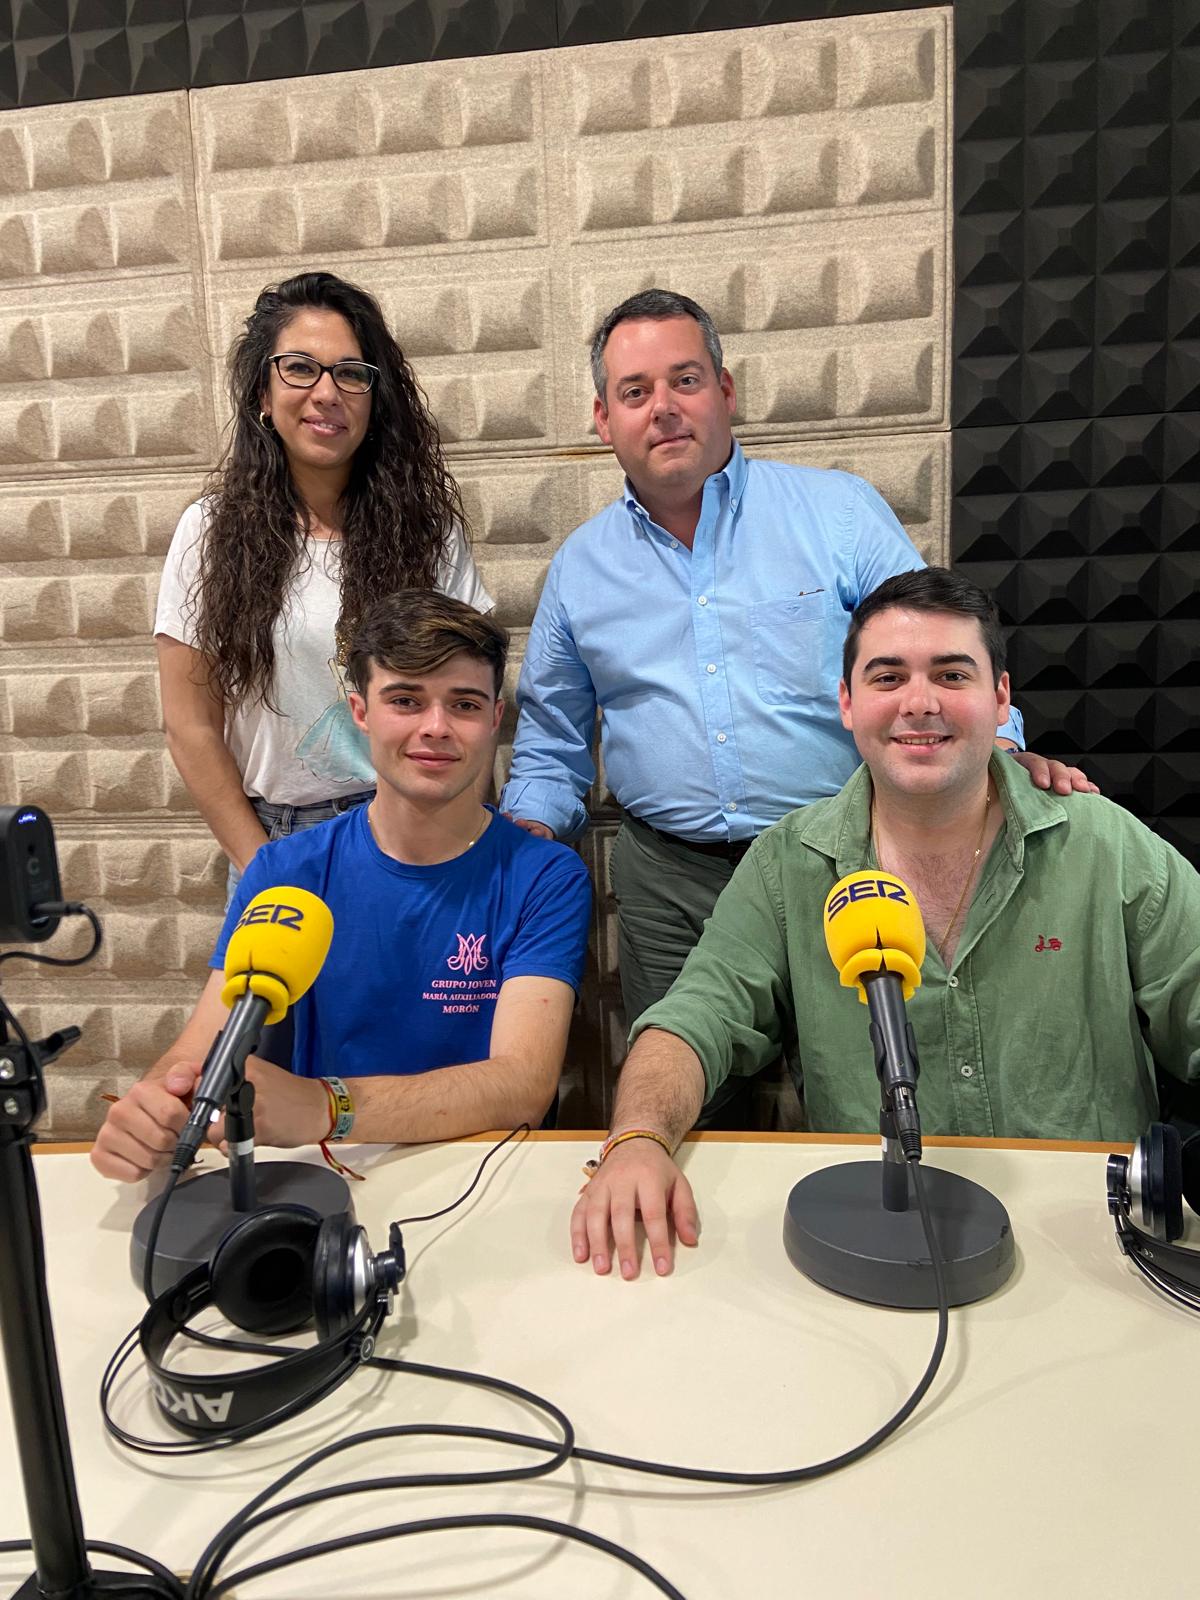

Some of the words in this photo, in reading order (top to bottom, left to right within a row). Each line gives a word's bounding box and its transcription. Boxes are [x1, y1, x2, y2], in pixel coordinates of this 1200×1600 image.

[828, 879, 910, 923] SER
[431, 979, 466, 989] GRUPO
[467, 979, 497, 990] JOVEN
[422, 991, 448, 1001] MARÍA
[442, 1003, 480, 1014] MORÓN
